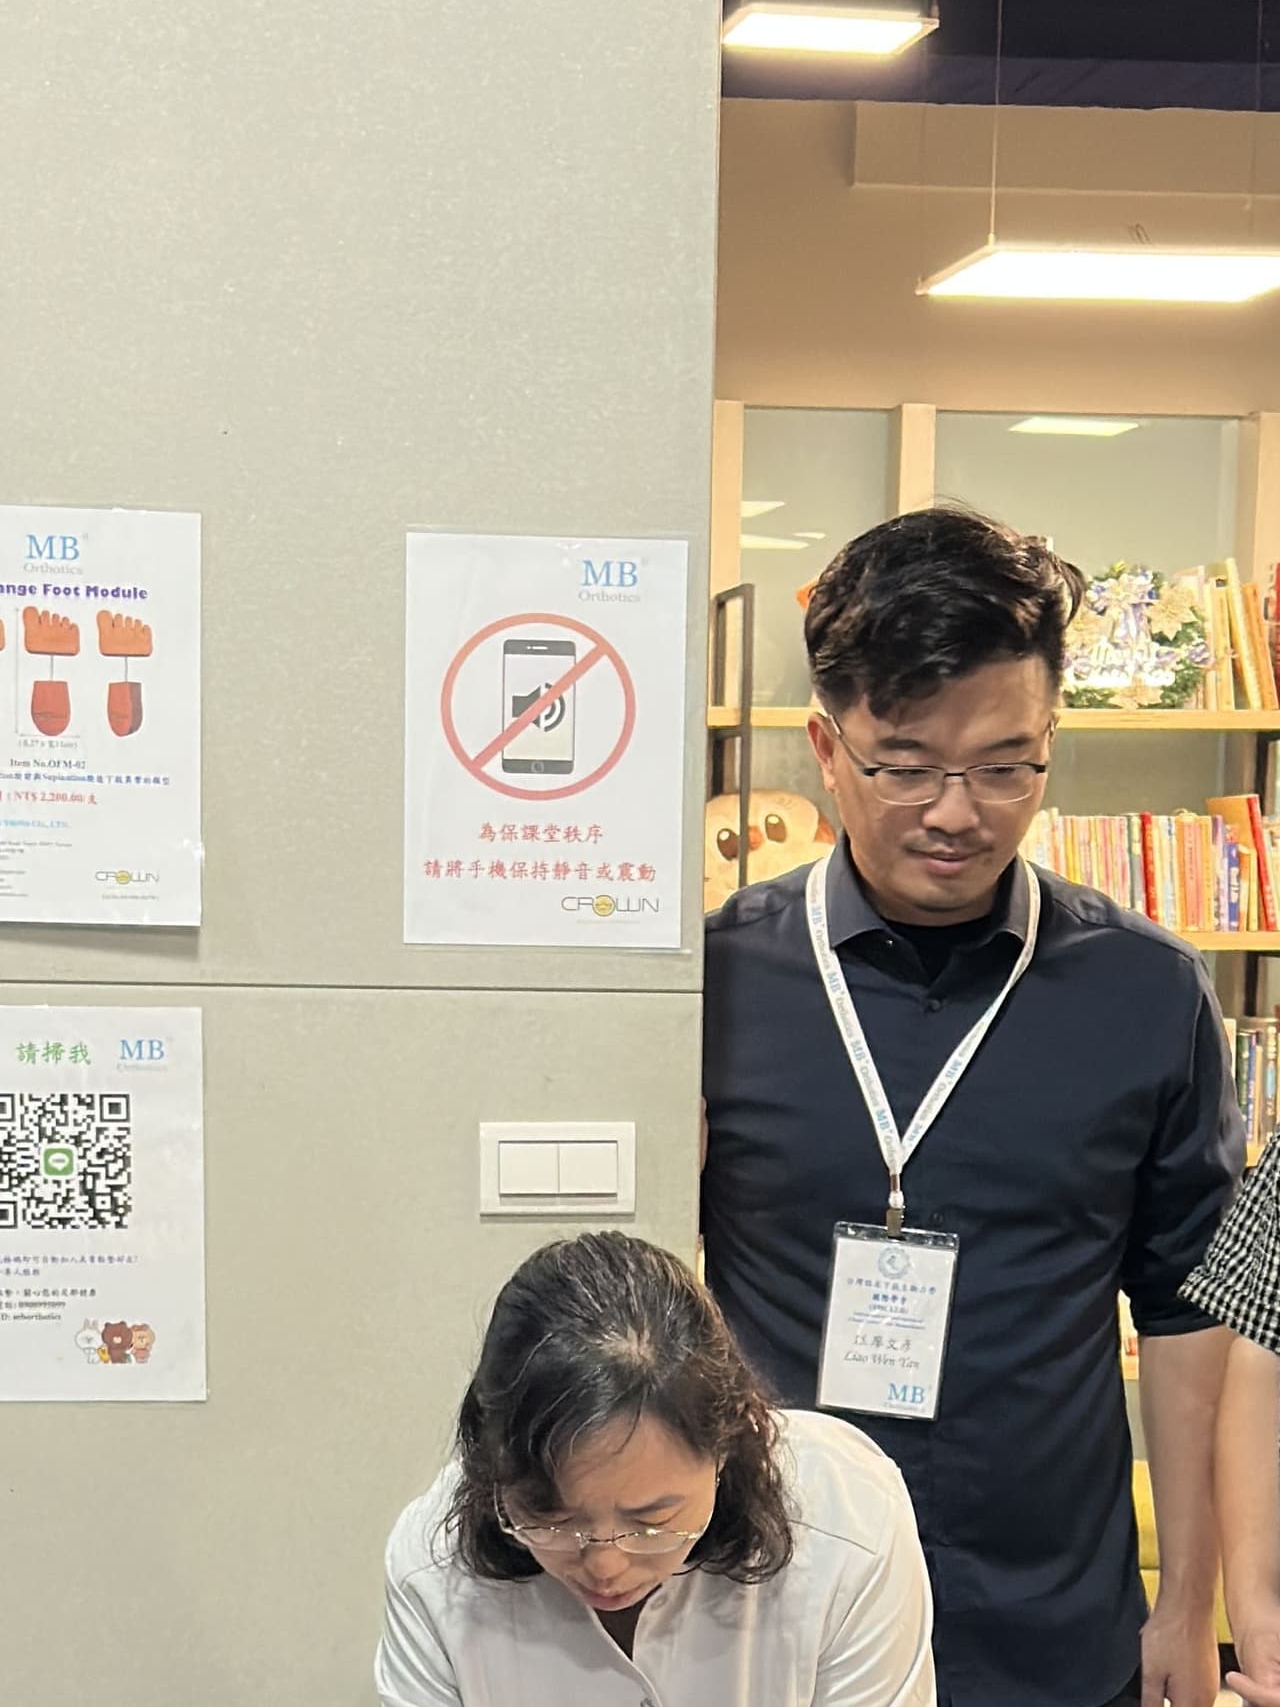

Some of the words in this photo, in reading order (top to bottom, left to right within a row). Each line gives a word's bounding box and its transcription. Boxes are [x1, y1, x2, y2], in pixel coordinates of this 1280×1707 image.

[26, 534, 80, 561] MB
[582, 560, 638, 587] MB
[43, 584, 80, 597] Foot
[86, 585, 148, 599] Module
[479, 822, 603, 844] 為保課堂秩序
[95, 870, 160, 885] CROWN
[423, 859, 657, 883] 請將手機保持靜音或震動
[561, 894, 660, 917] CROWN
[17, 1041, 91, 1065] 請掃我
[119, 1039, 165, 1061] MB
[875, 1109, 890, 1131] MB
[887, 1382, 925, 1404] MB
